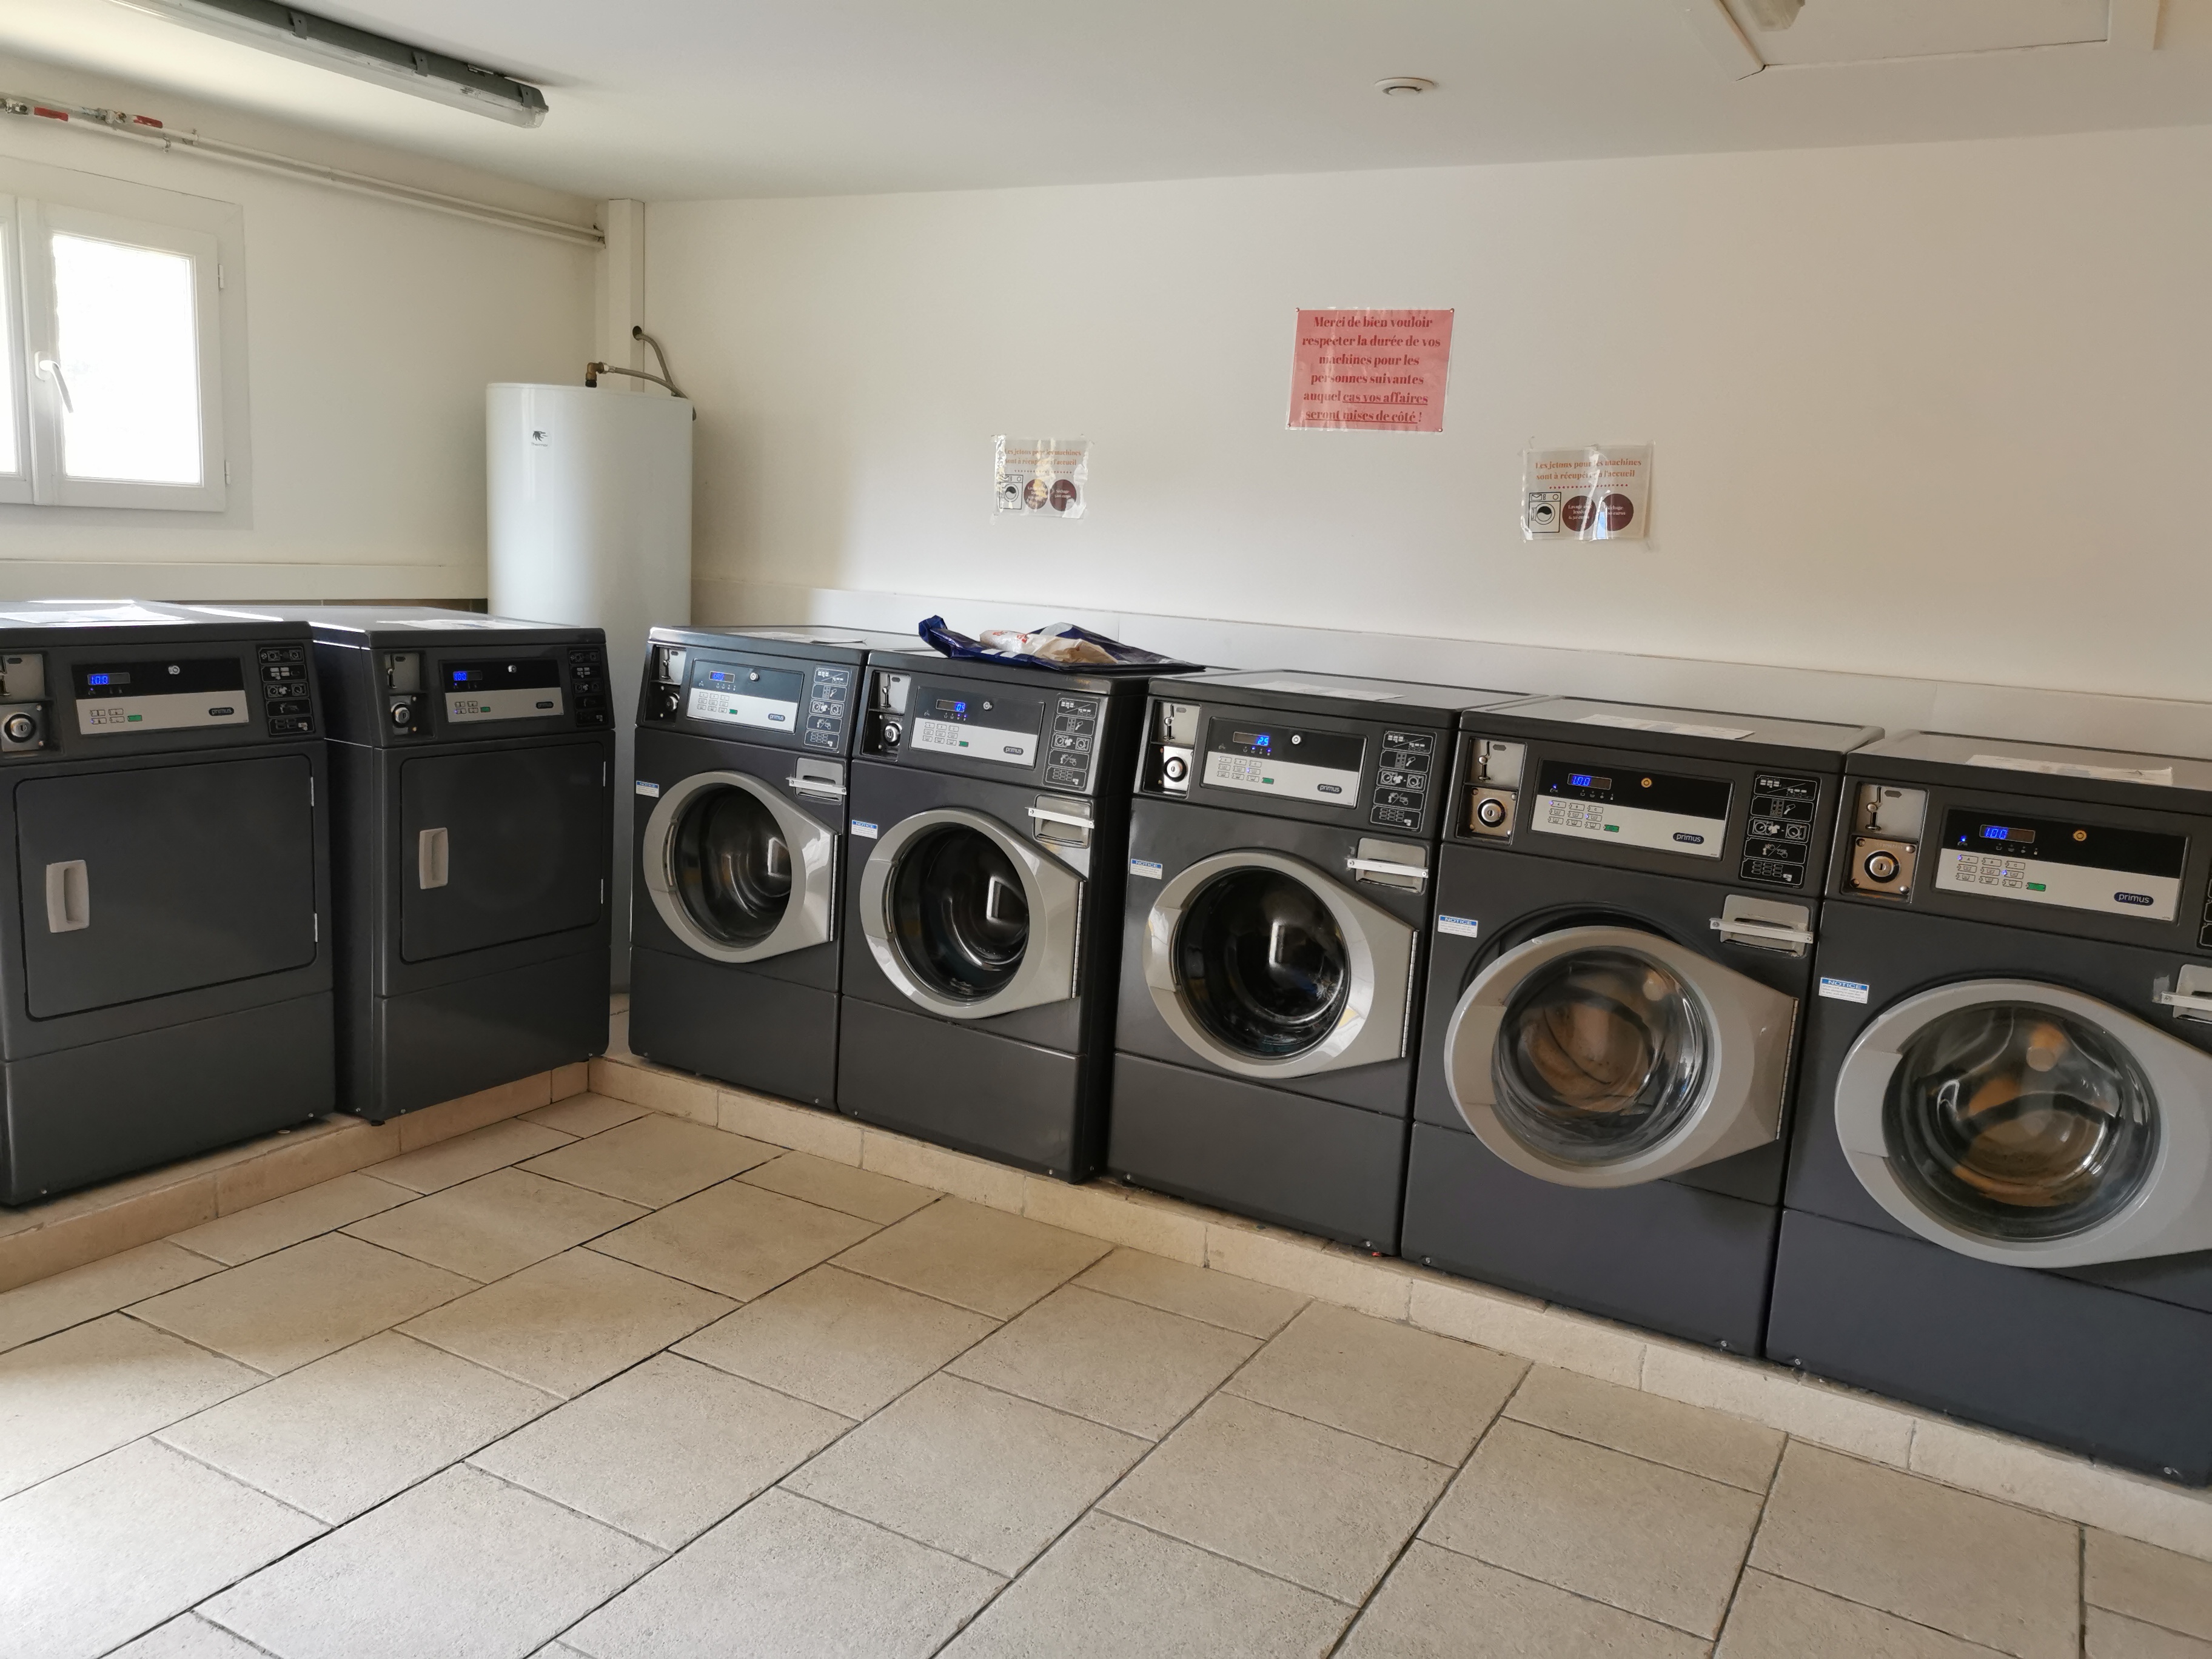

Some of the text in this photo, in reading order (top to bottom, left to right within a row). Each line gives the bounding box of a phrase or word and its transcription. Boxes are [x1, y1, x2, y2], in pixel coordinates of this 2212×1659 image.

[1313, 316, 1432, 327] Merci de bien vouloir
[1302, 335, 1441, 348] respecter la durée de vos
[1319, 354, 1419, 368] machines pour les
[1310, 373, 1424, 385] personnes suivantes
[1303, 390, 1428, 404] auquel cas vos affaires
[1305, 410, 1423, 423] seront mises de côté !
[1549, 461, 1572, 470] jetons
[1605, 458, 1641, 466] machines
[1257, 736, 1269, 746] 25
[1676, 834, 1701, 842] primus
[2118, 894, 2150, 903] primus
[1828, 980, 1862, 990] NOTICE
